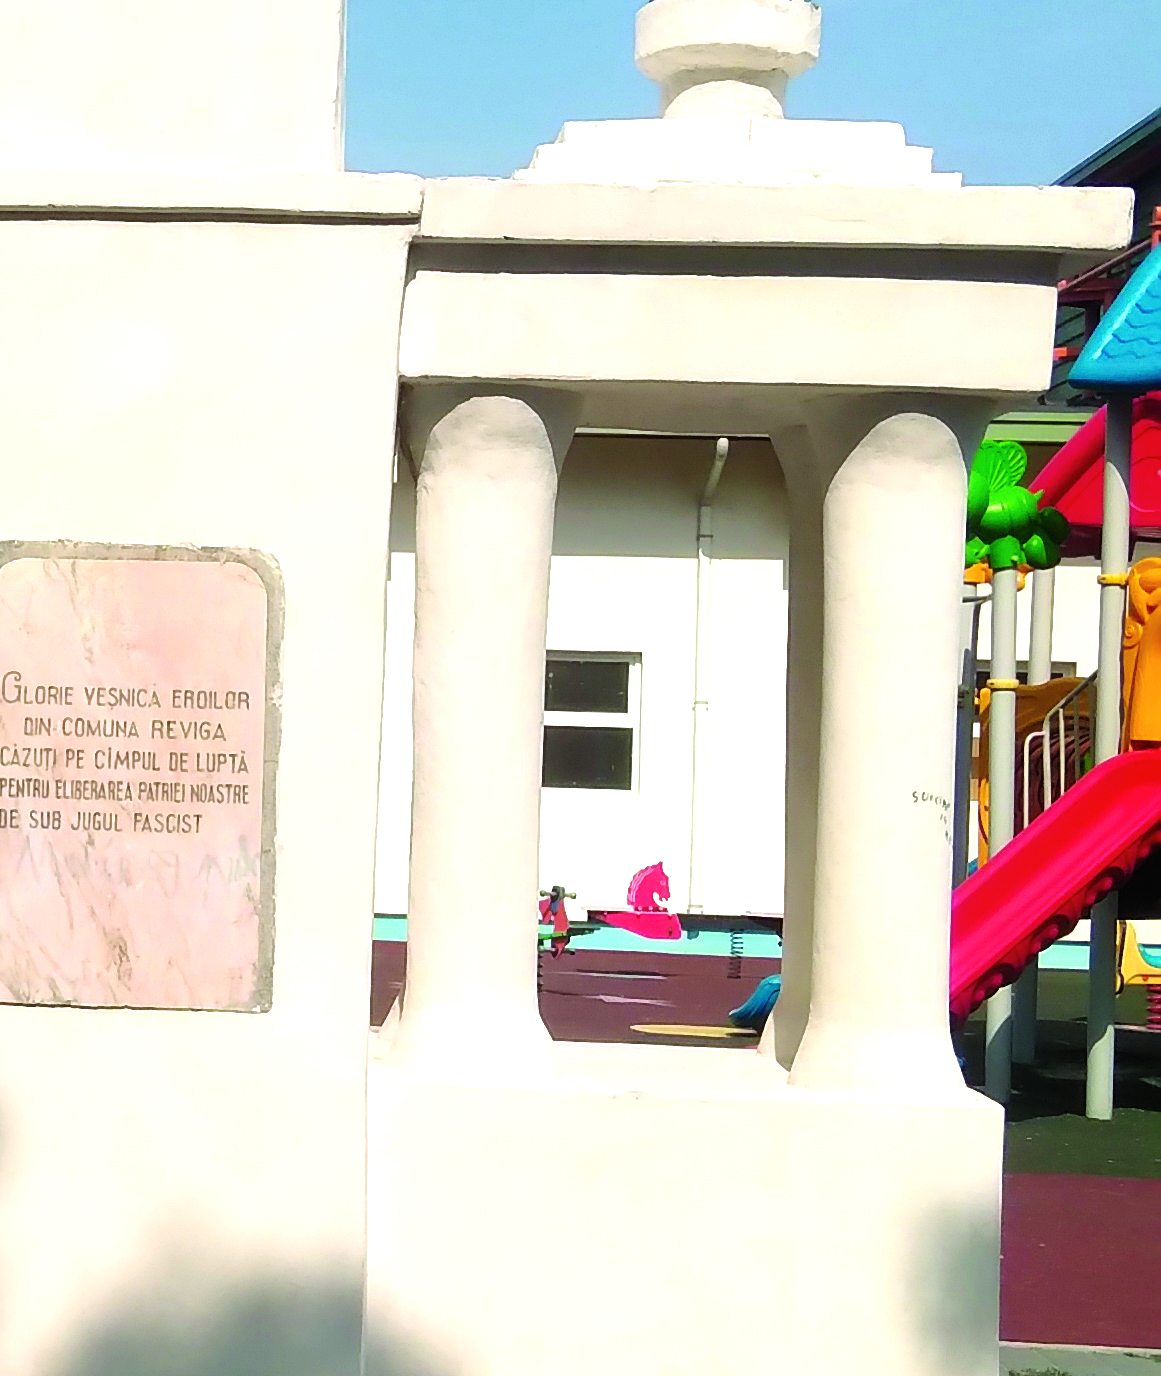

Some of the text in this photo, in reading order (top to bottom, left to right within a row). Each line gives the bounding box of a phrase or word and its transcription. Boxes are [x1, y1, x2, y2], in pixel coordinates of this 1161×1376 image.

[172, 689, 251, 711] EROILOR
[24, 717, 227, 742] DIN COMUNA REVIGA
[65, 749, 85, 770] PE
[169, 752, 189, 773] DE
[0, 777, 250, 805] PENTRU ELIBERAREA PATRIEI NOASTRE
[29, 810, 62, 831] SUB
[70, 811, 123, 832] JUGUL
[133, 812, 203, 834] FASCIST
